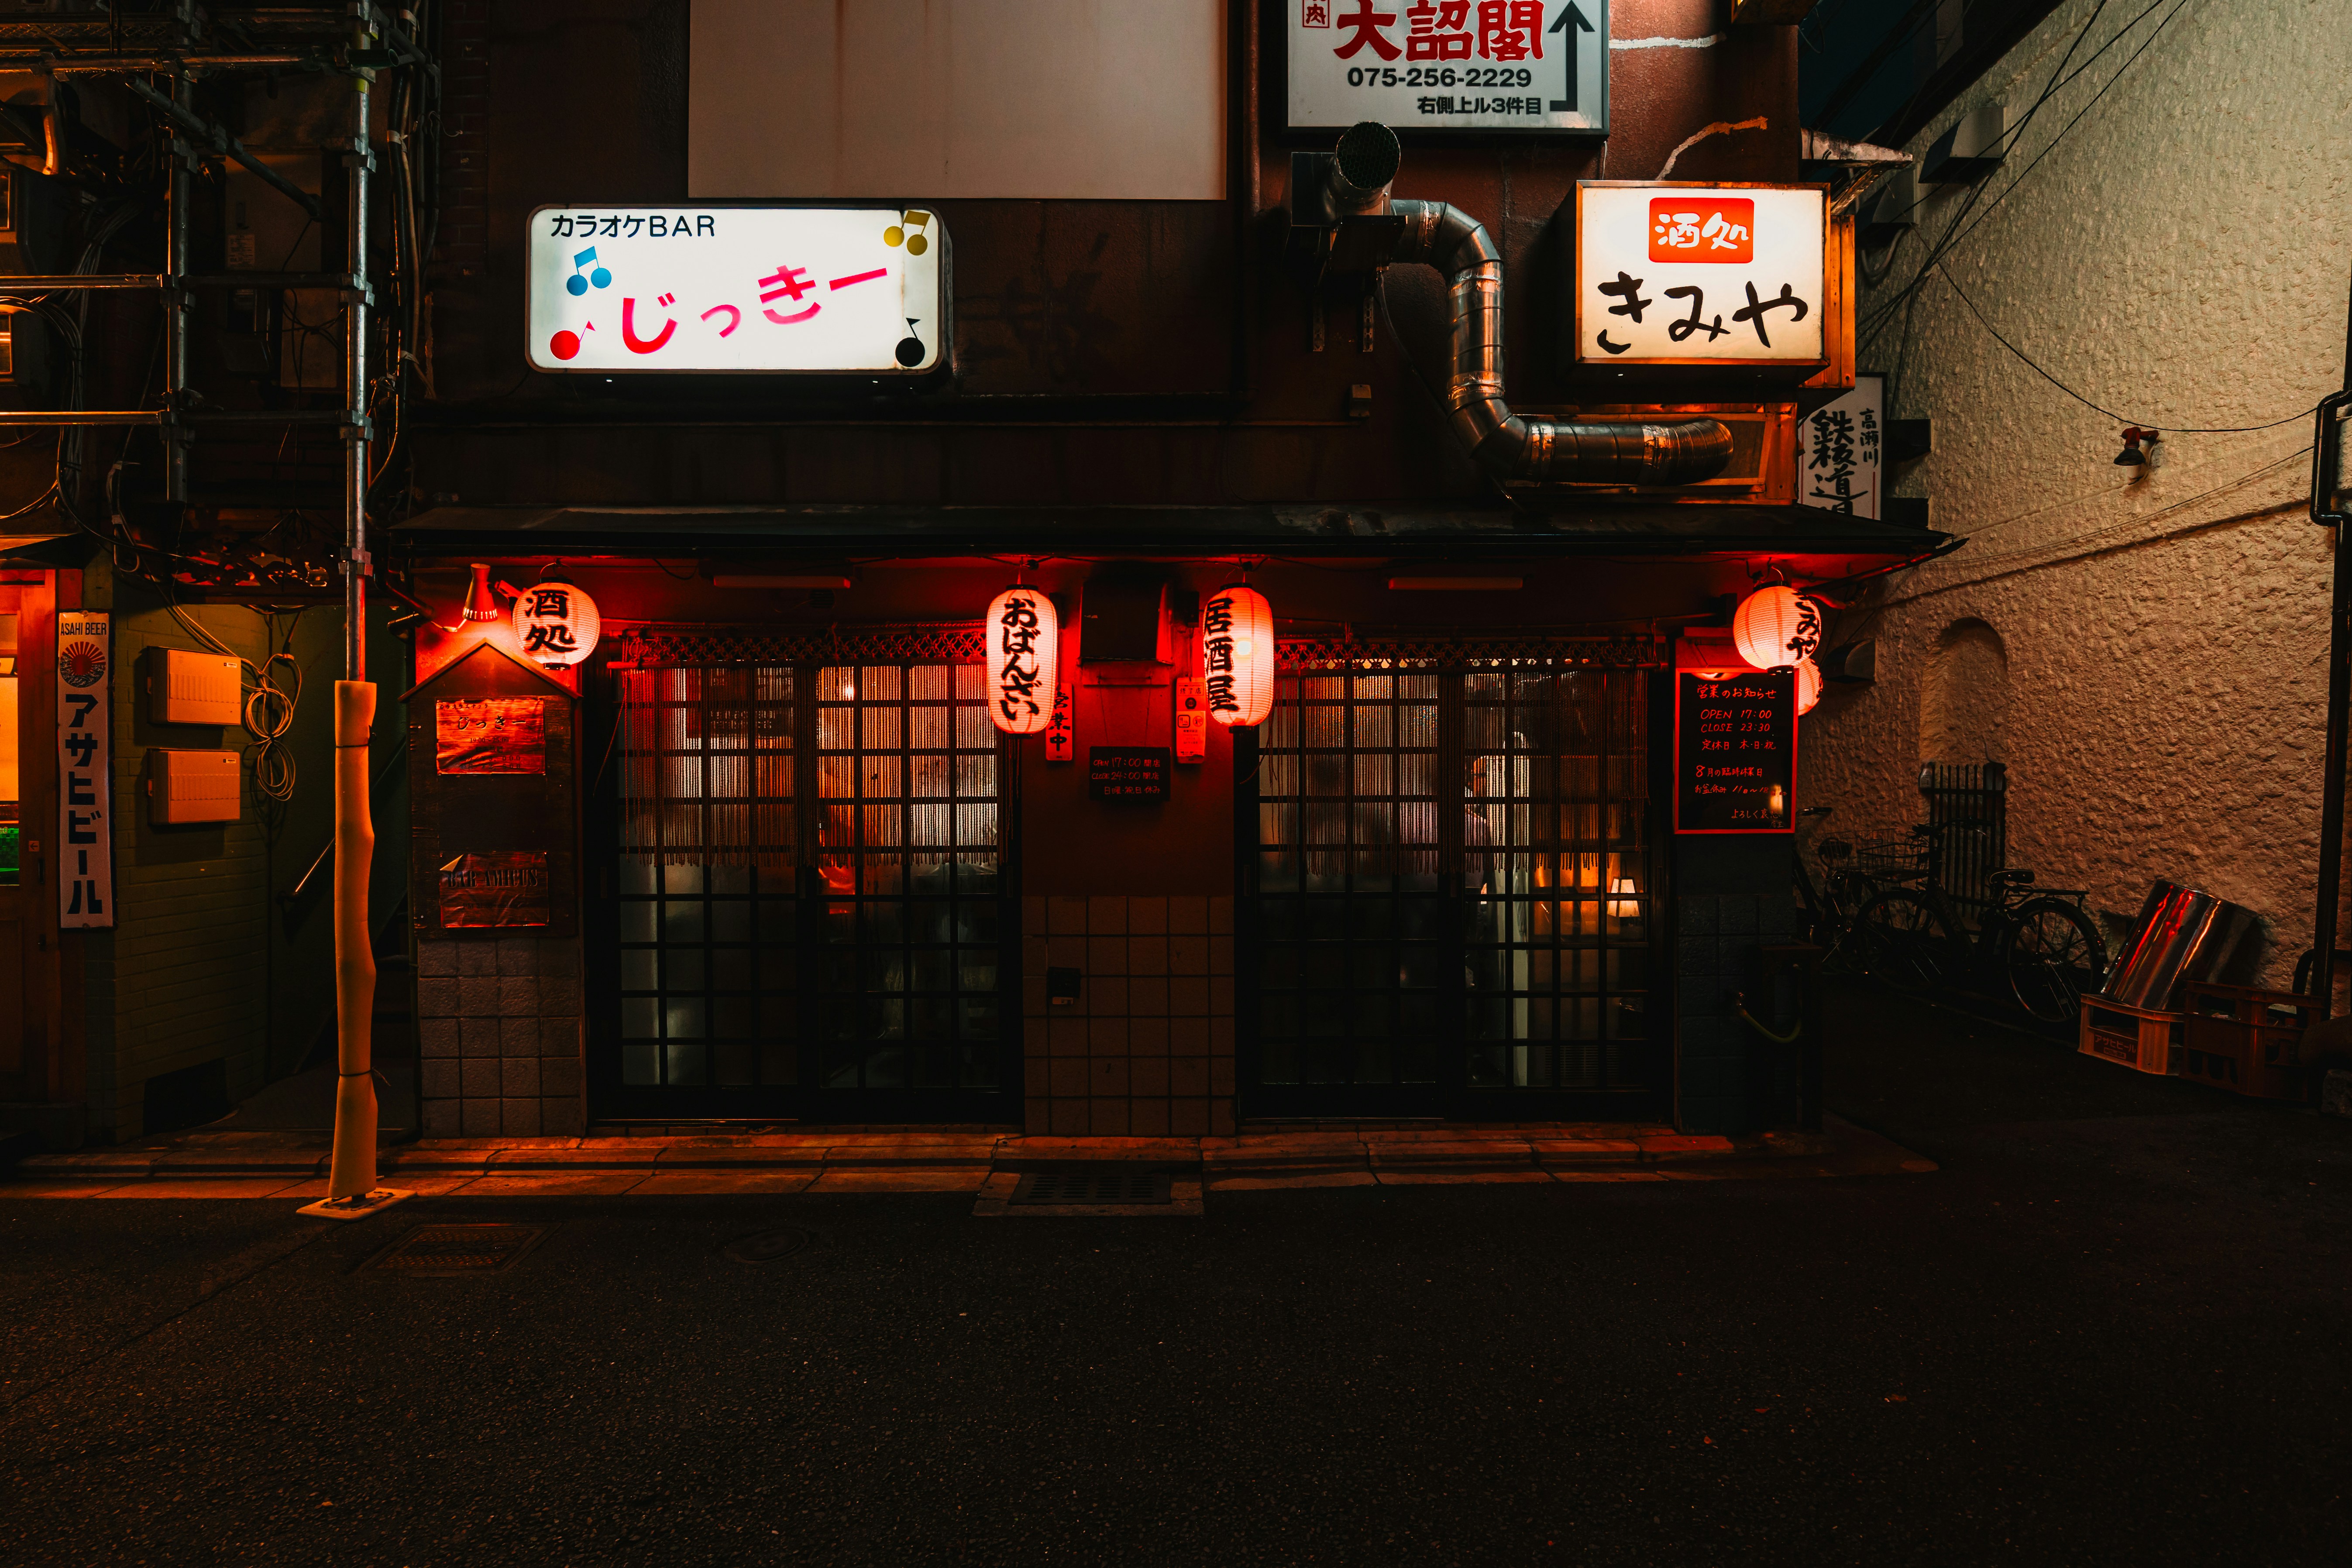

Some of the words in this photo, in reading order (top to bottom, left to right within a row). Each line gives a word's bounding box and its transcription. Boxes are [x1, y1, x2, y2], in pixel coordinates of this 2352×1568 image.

[1306, 0, 1326, 24] 肉
[1348, 68, 1531, 87] 075-256-2229
[1417, 96, 1542, 115] 右側上ル3件目
[551, 215, 715, 238] カラオケBAR
[1655, 212, 1749, 249] 酒処
[622, 265, 888, 354] じっきー
[1597, 271, 1808, 354] きみや
[60, 622, 83, 636] ASAHI
[86, 622, 107, 635] BEER
[525, 590, 579, 653] 酒処
[999, 598, 1040, 721] おばんざい
[1204, 598, 1241, 712] 居酒屋
[1697, 684, 1777, 699] 営業のお知らせ
[458, 715, 526, 730] じっきー
[1049, 691, 1071, 751] 営業中
[1701, 709, 1732, 719] OPEN
[1741, 709, 1772, 719] 17:00
[1701, 723, 1733, 732] CLOSE
[1740, 723, 1770, 732] 23:30
[1702, 739, 1729, 750] 定休日
[1112, 757, 1141, 767] 17:00
[1696, 765, 1763, 777] 8月の臨時休業日
[1111, 771, 1140, 780] 24:00
[1145, 786, 1160, 794] 休み
[1695, 784, 1726, 794] お盆休み
[65, 694, 103, 915] アサヒビール
[448, 871, 478, 888] BAR
[484, 870, 538, 887] AMICUS
[2095, 1035, 2136, 1053] アサヒビール
